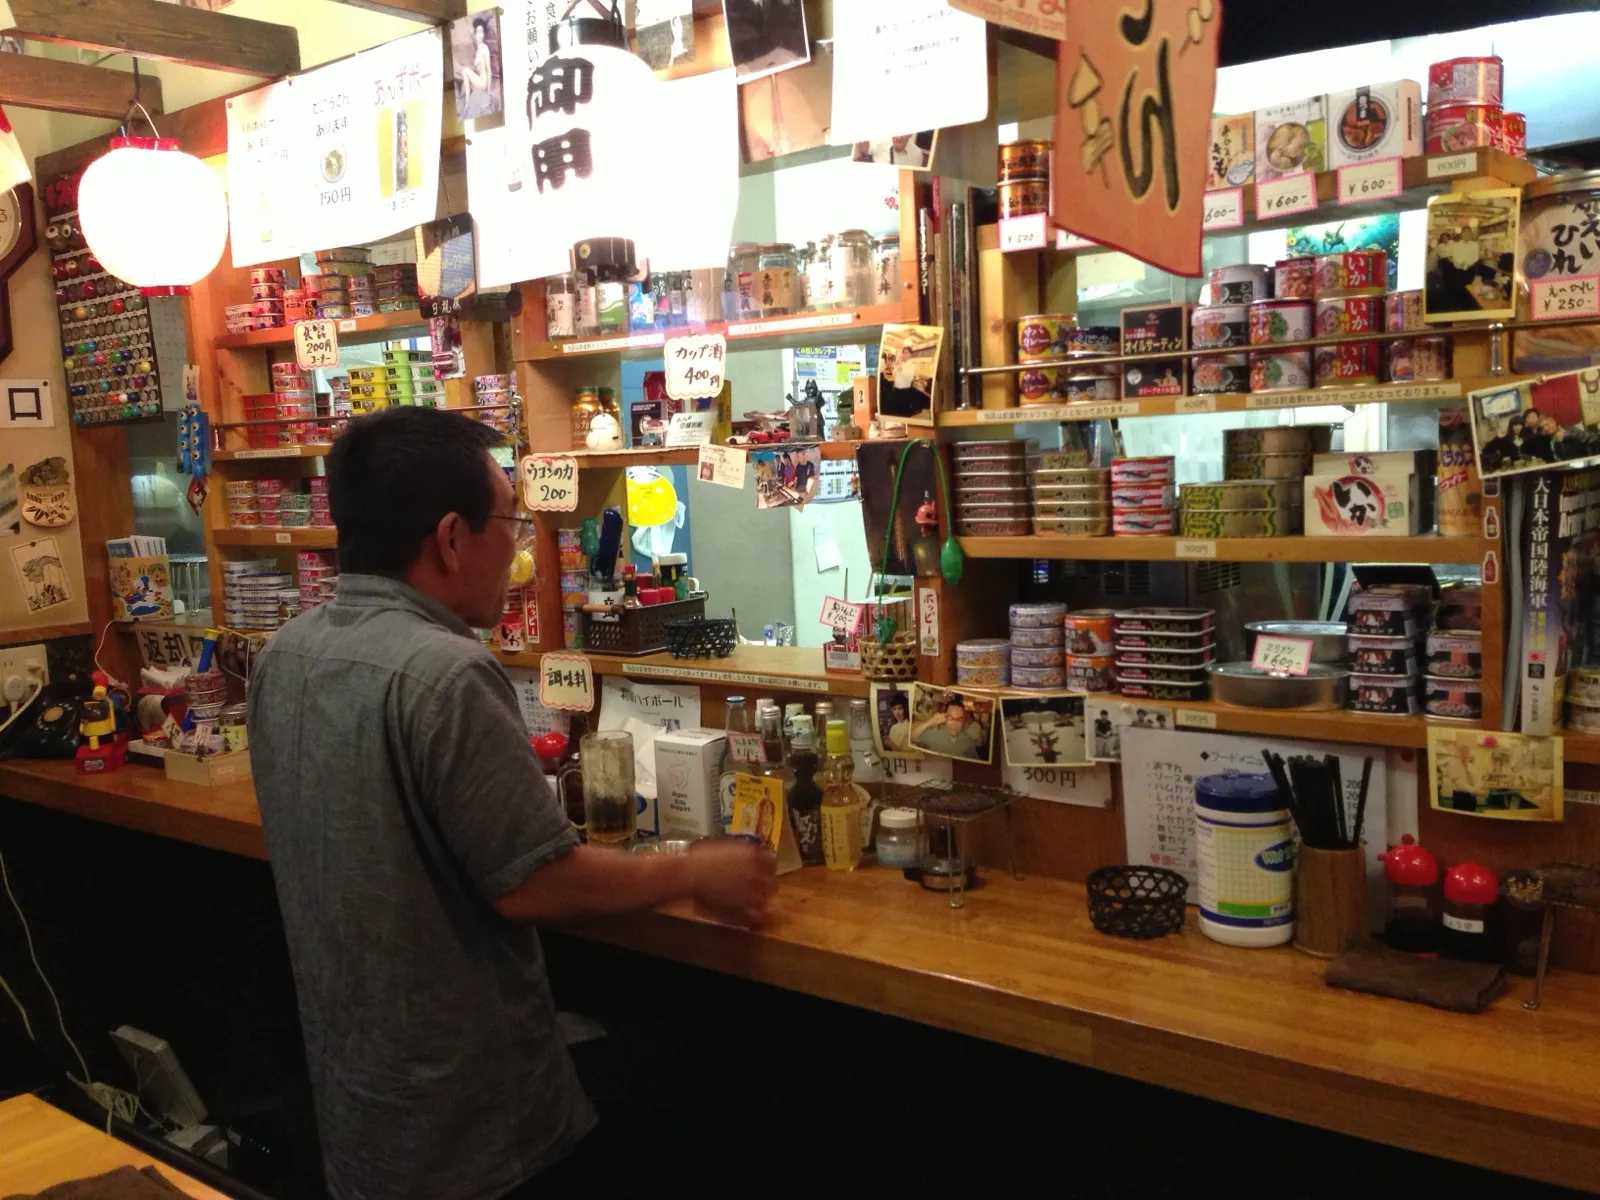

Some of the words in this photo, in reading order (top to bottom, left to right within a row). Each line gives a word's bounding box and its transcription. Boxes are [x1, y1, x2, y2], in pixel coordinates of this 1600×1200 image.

[319, 187, 352, 206] 150円
[675, 343, 722, 361] カップ酒
[684, 366, 720, 388] 400円
[923, 593, 936, 636] ホッピー
[545, 667, 588, 693] 調味料
